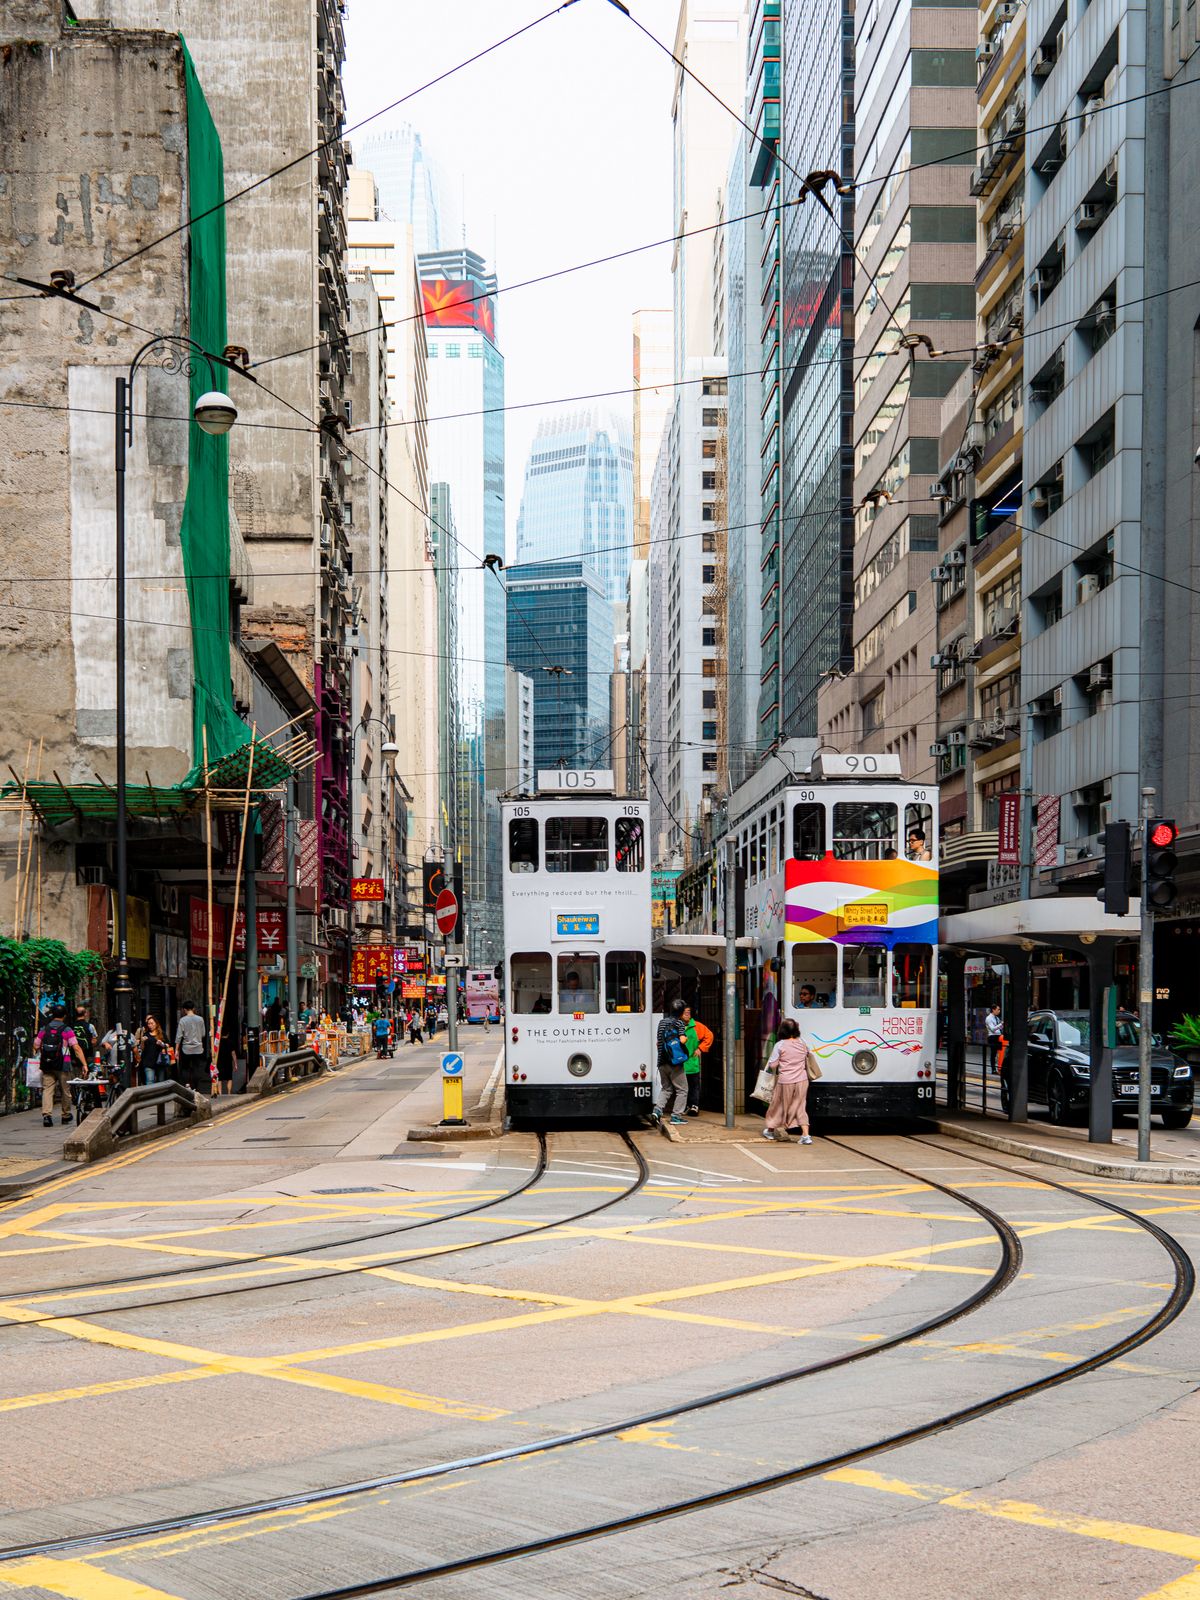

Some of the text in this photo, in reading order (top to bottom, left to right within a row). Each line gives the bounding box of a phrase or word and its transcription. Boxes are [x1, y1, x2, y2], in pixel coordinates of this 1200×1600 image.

[845, 755, 878, 773] 90
[558, 771, 597, 788] 105
[801, 791, 815, 801] 90
[913, 790, 927, 801] 90
[513, 807, 530, 816] 105
[622, 806, 640, 816] 105
[352, 881, 382, 895] 好彩
[882, 1017, 915, 1026] HONG
[552, 1027, 630, 1036] OUTNET.COM
[882, 1026, 915, 1034] KONG
[634, 1086, 651, 1098] 105
[917, 1088, 932, 1098] 90
